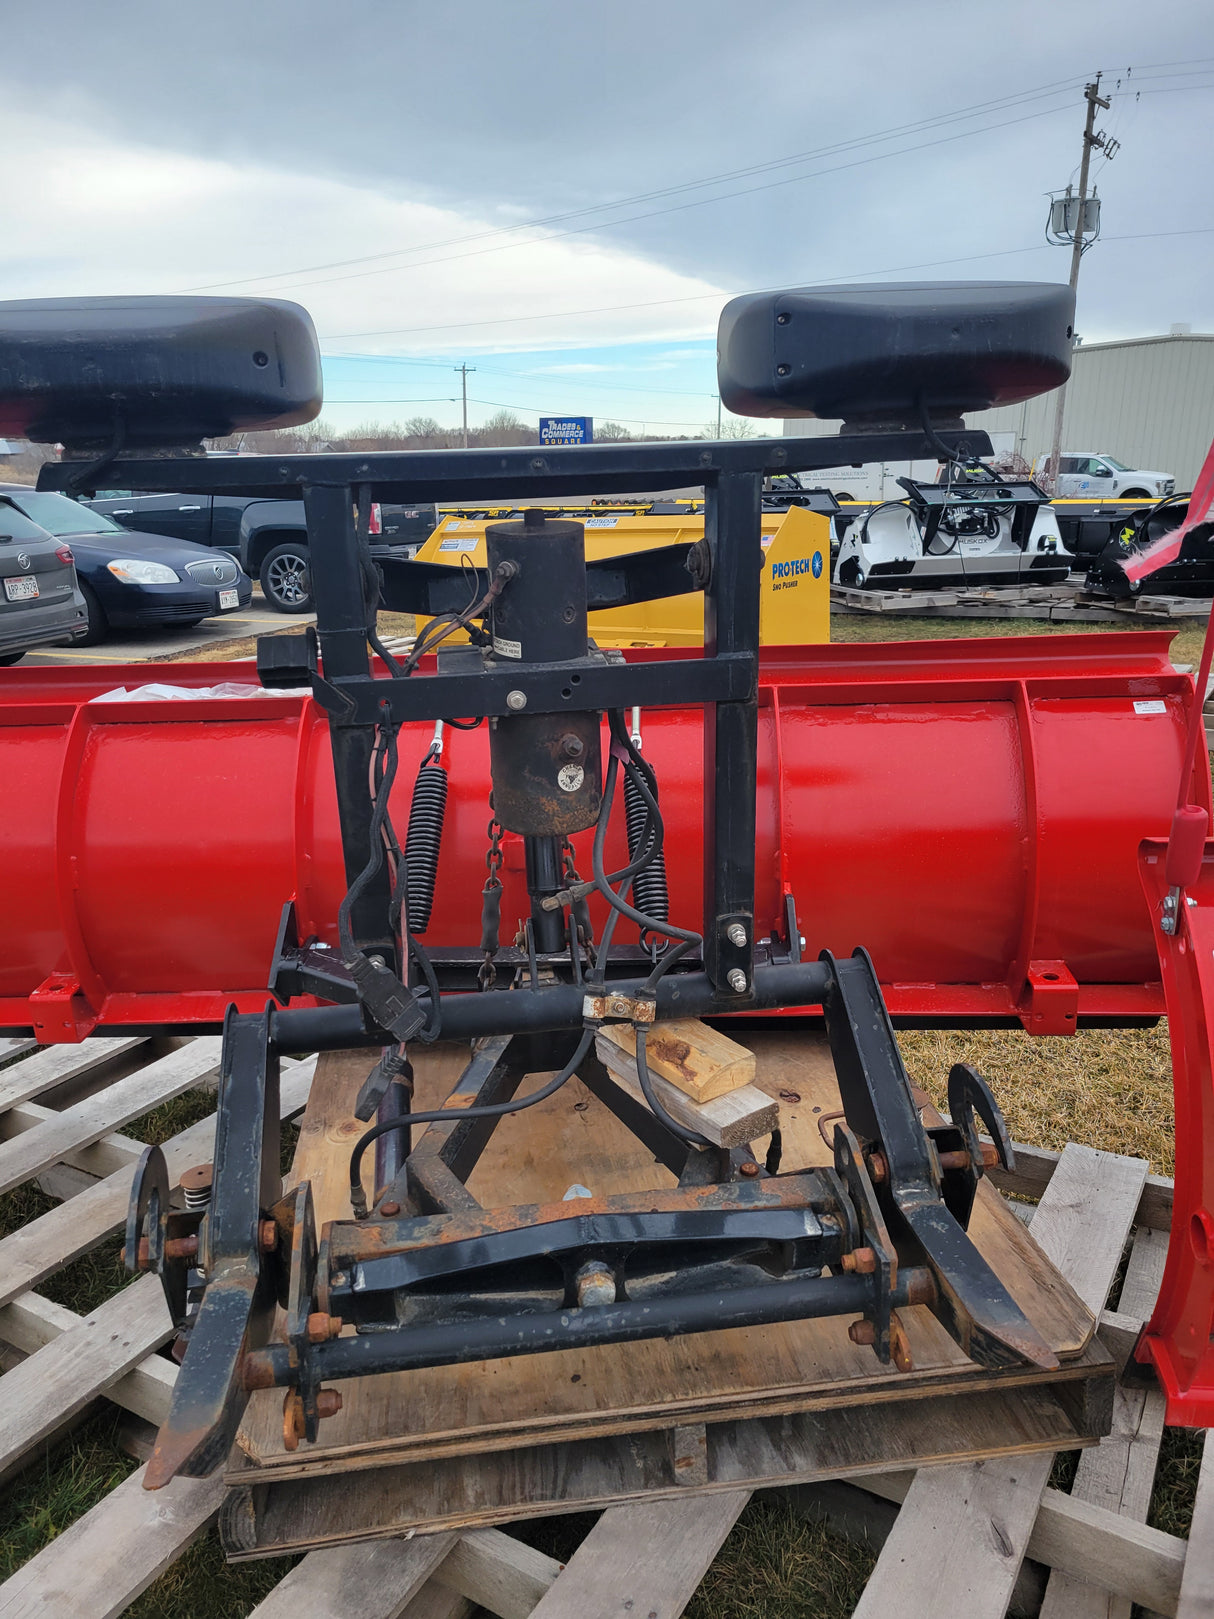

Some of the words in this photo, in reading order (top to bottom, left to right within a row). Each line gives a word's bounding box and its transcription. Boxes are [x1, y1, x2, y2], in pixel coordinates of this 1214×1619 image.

[548, 420, 576, 431] TRADES
[542, 428, 584, 438] COMMERCE
[772, 583, 781, 591] SNO
[782, 580, 798, 589] PUSHER
